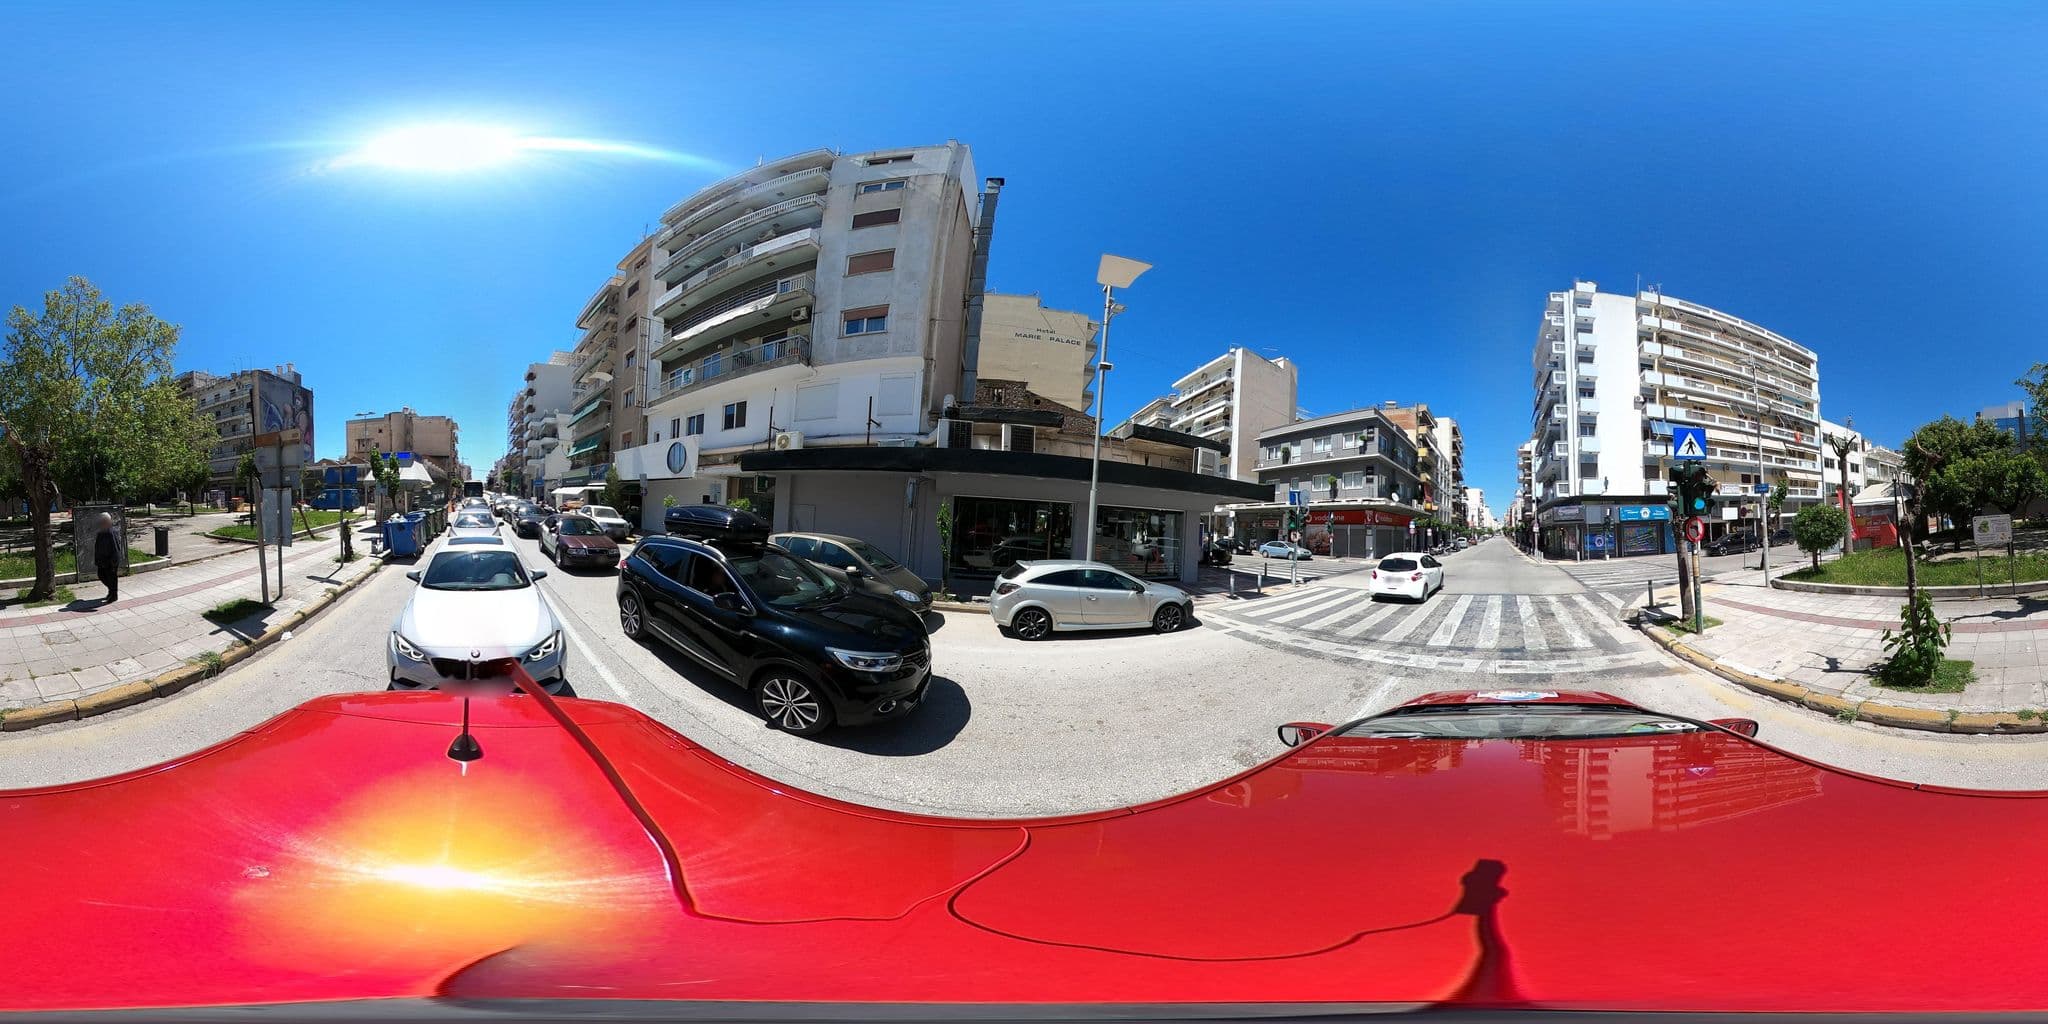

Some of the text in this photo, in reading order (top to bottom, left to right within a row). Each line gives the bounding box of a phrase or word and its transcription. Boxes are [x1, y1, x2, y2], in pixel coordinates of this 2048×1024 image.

[1014, 332, 1081, 346] MARIE PALACE
[1314, 513, 1345, 521] vodaone
